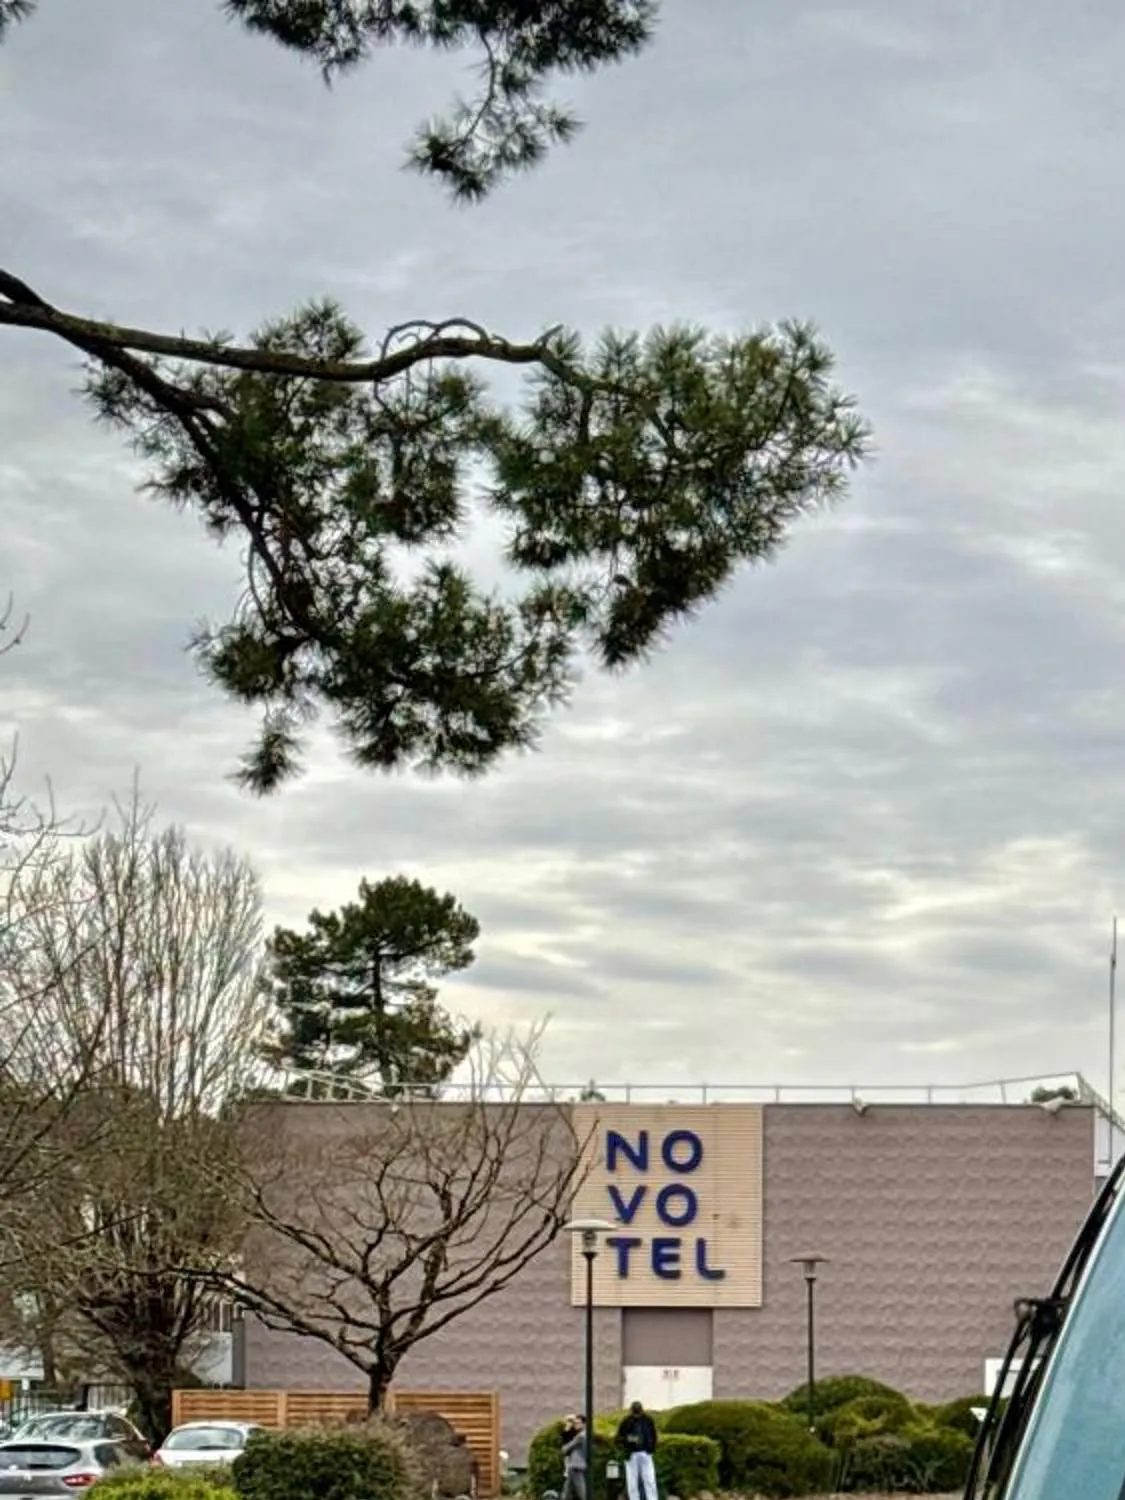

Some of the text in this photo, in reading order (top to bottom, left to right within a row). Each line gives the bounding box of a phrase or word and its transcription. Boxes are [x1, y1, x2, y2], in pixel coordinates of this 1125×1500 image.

[606, 1129, 704, 1173] NO
[607, 1183, 698, 1227] VO
[605, 1237, 726, 1280] TEL
